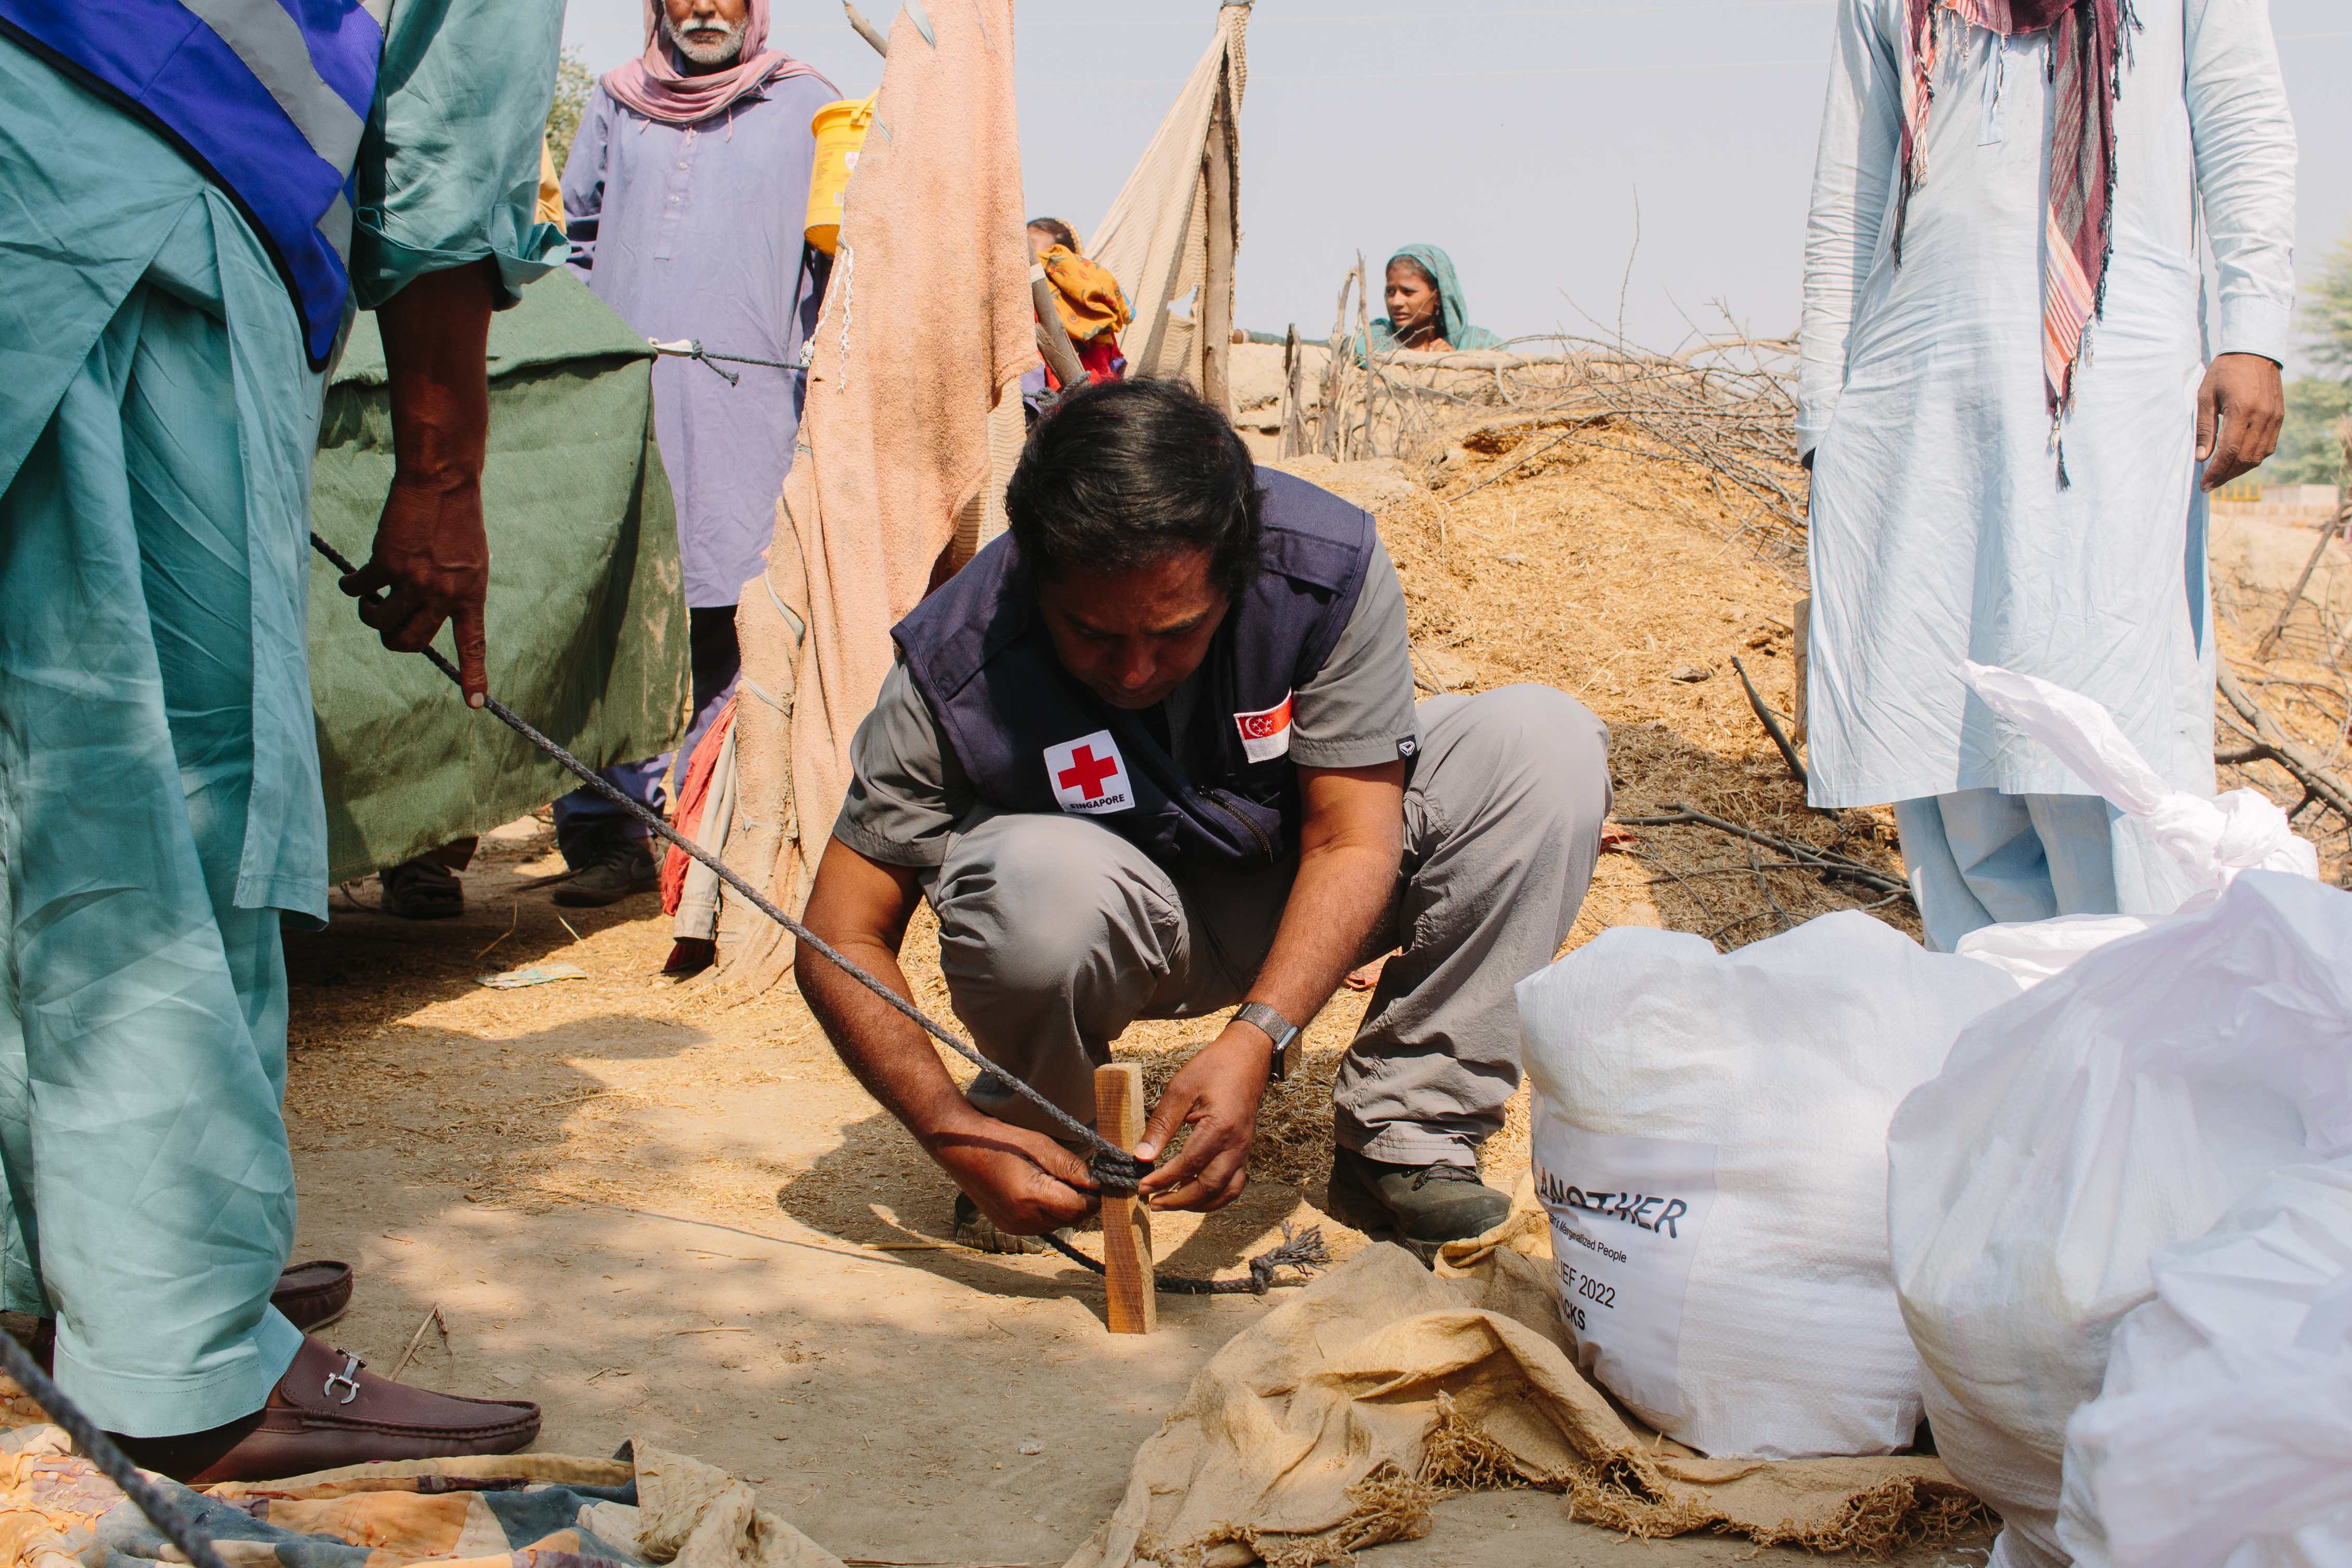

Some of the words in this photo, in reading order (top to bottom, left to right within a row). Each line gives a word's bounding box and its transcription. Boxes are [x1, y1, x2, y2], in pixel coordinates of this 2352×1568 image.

[1070, 794, 1125, 809] SINGAPORE
[1540, 1167, 1687, 1238] ANOTHER
[1559, 1220, 1596, 1251] Marginalized
[1597, 1242, 1627, 1263] People
[1578, 1275, 1615, 1309] 2022
